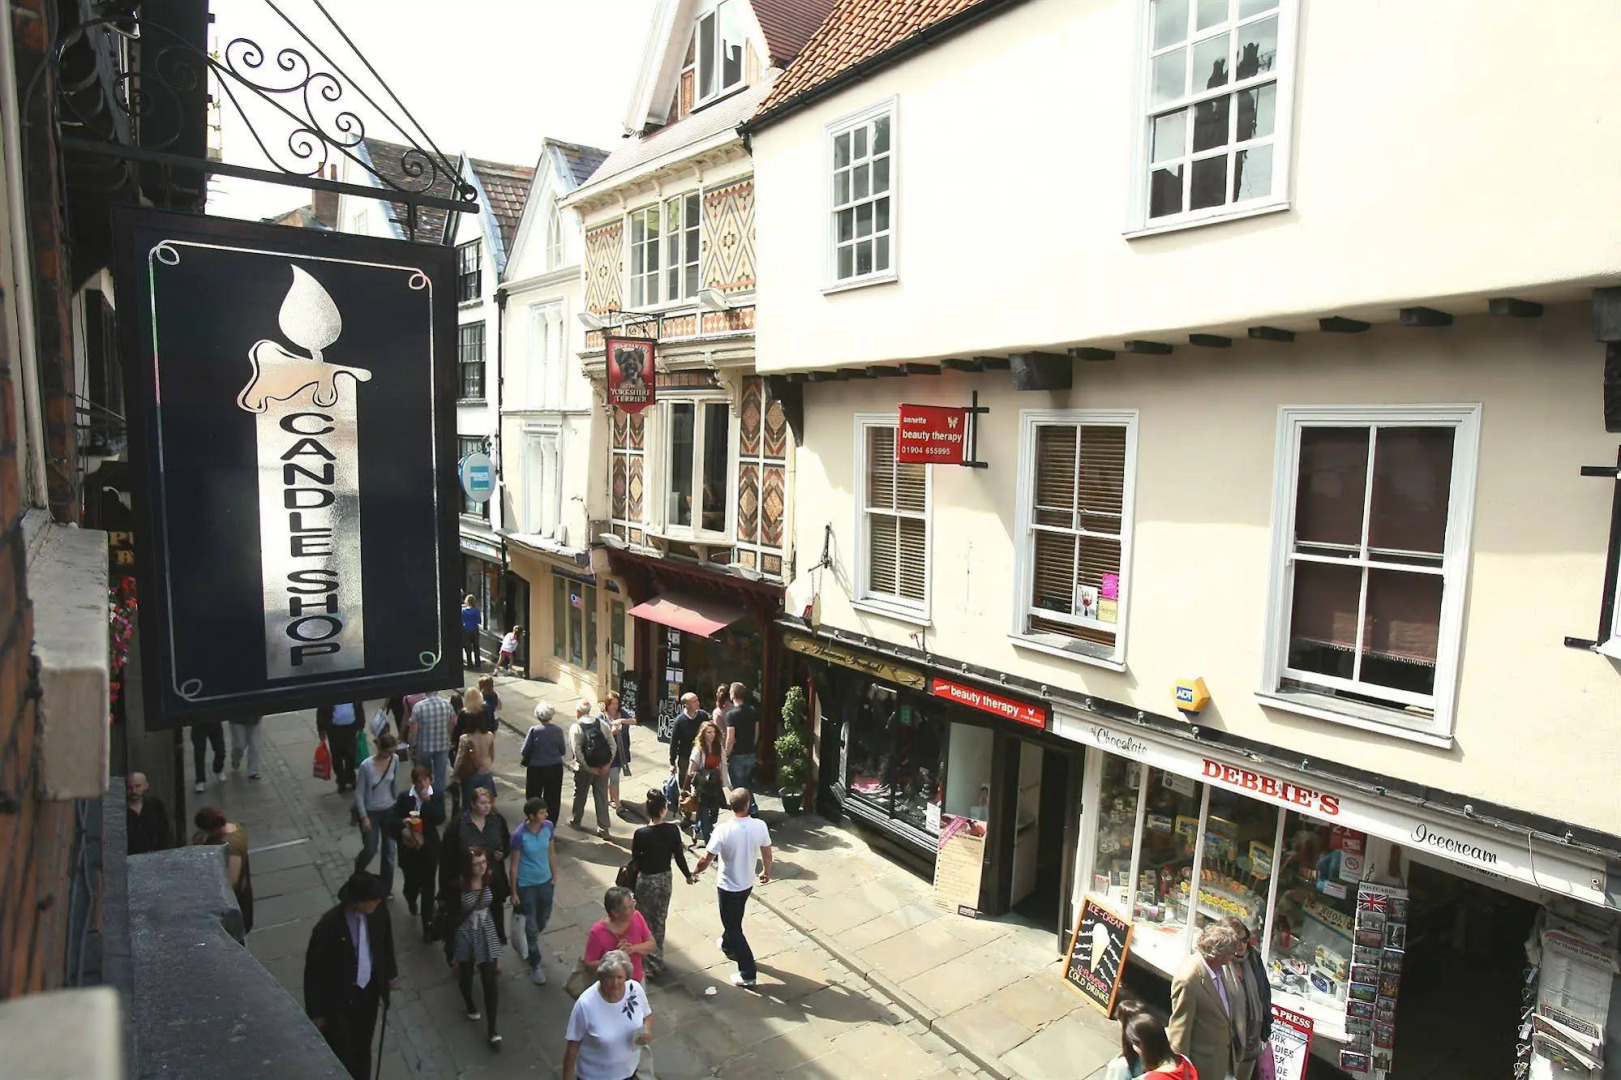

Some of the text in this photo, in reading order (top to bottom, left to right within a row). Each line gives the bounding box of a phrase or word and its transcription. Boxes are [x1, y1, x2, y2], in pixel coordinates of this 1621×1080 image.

[903, 416, 927, 424] annette
[901, 446, 923, 454] 01904
[902, 429, 963, 443] beauty therapy
[279, 411, 343, 666] CANDLE SHOP
[951, 685, 980, 705] beauty
[982, 696, 1019, 717] therapy
[1097, 727, 1148, 755] Chocolate
[1201, 758, 1340, 816] DEBBIE'S
[1411, 823, 1498, 865] Icecream
[1280, 1009, 1311, 1029] PRESS
